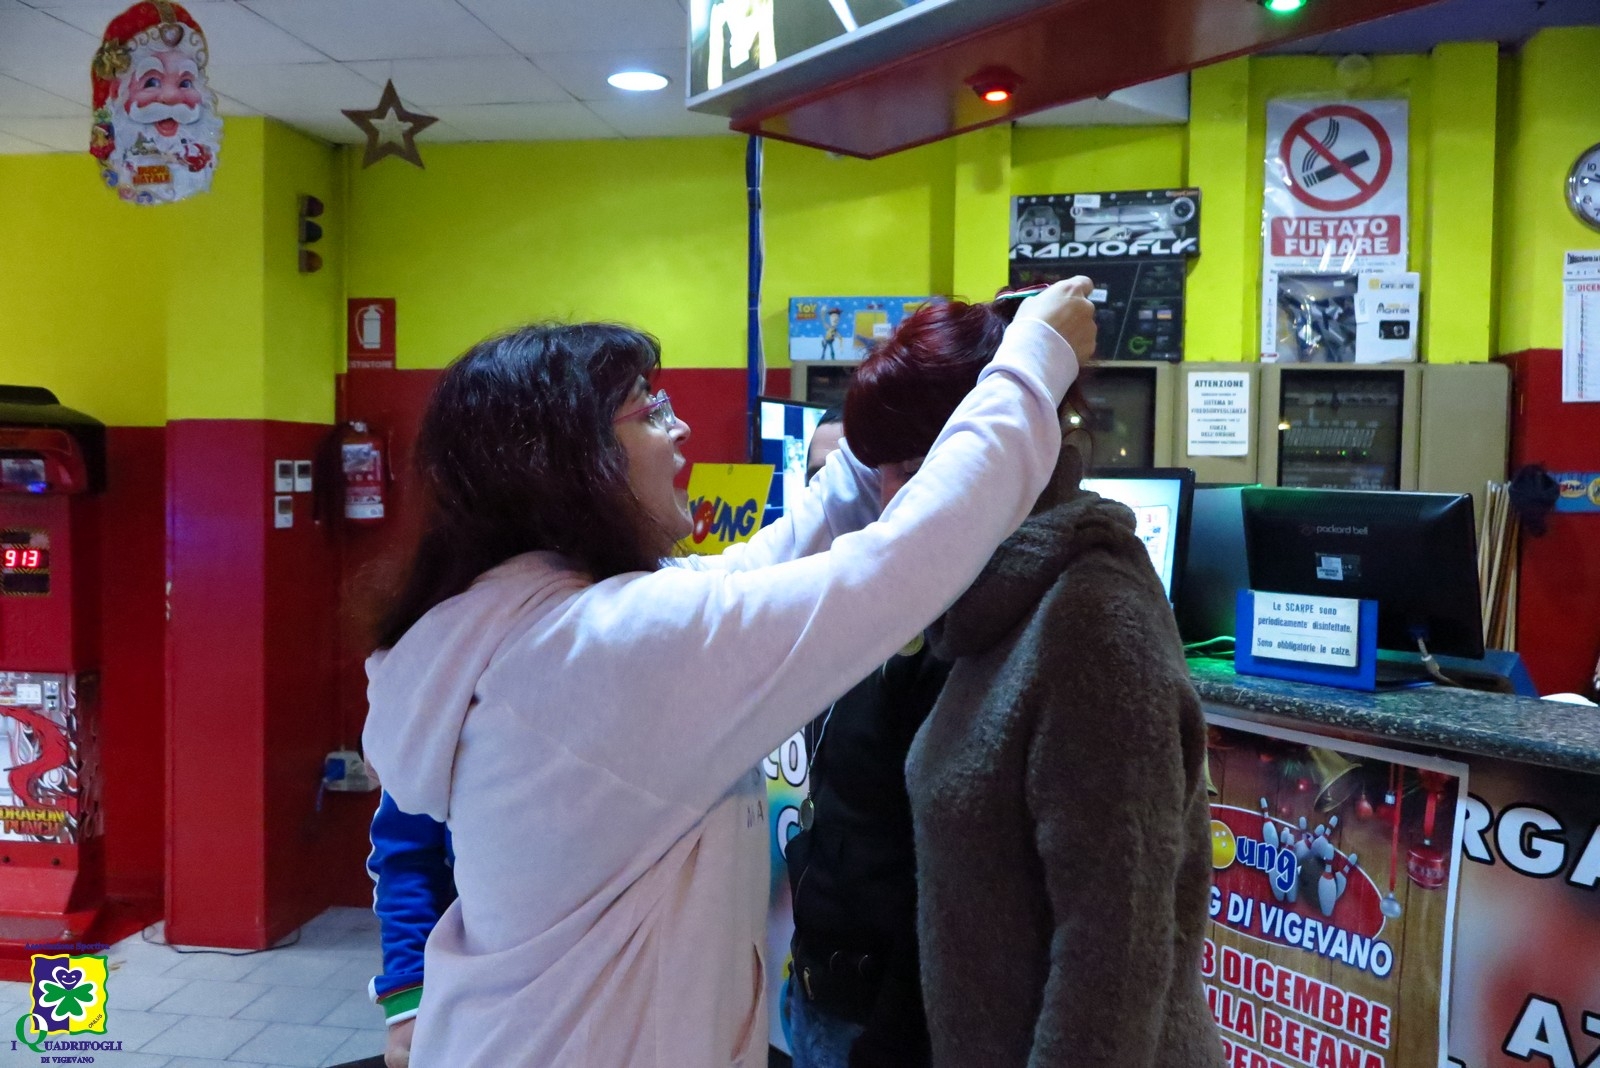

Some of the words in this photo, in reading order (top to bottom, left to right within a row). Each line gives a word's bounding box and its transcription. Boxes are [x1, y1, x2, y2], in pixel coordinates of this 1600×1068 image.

[1282, 218, 1388, 237] VIETATO
[1009, 237, 1197, 260] RADIOFLY
[1284, 237, 1389, 255] FUMARE
[797, 303, 817, 313] TOY
[1195, 379, 1244, 388] ATTENZIONE
[689, 495, 758, 544] YOUNG
[1316, 524, 1352, 534] packard
[1352, 526, 1369, 535] bell
[5, 549, 39, 567] 913
[1273, 601, 1281, 611] Le
[1285, 602, 1314, 613] SCARPE
[1319, 606, 1337, 616] sono
[1257, 616, 1308, 629] periodicamente
[1312, 620, 1353, 633] disinfettate.
[1256, 637, 1273, 648] Sono
[1277, 641, 1316, 653] obbligatorie
[1320, 644, 1327, 654] le
[1330, 646, 1351, 656] calze.
[0, 808, 65, 821] DRAGON
[4, 820, 61, 834] PUNCH
[1227, 891, 1253, 928] DI
[1259, 900, 1393, 978] VIGEVANO
[1221, 946, 1391, 1049] DICEMBRE
[1202, 982, 1257, 1042] LLA
